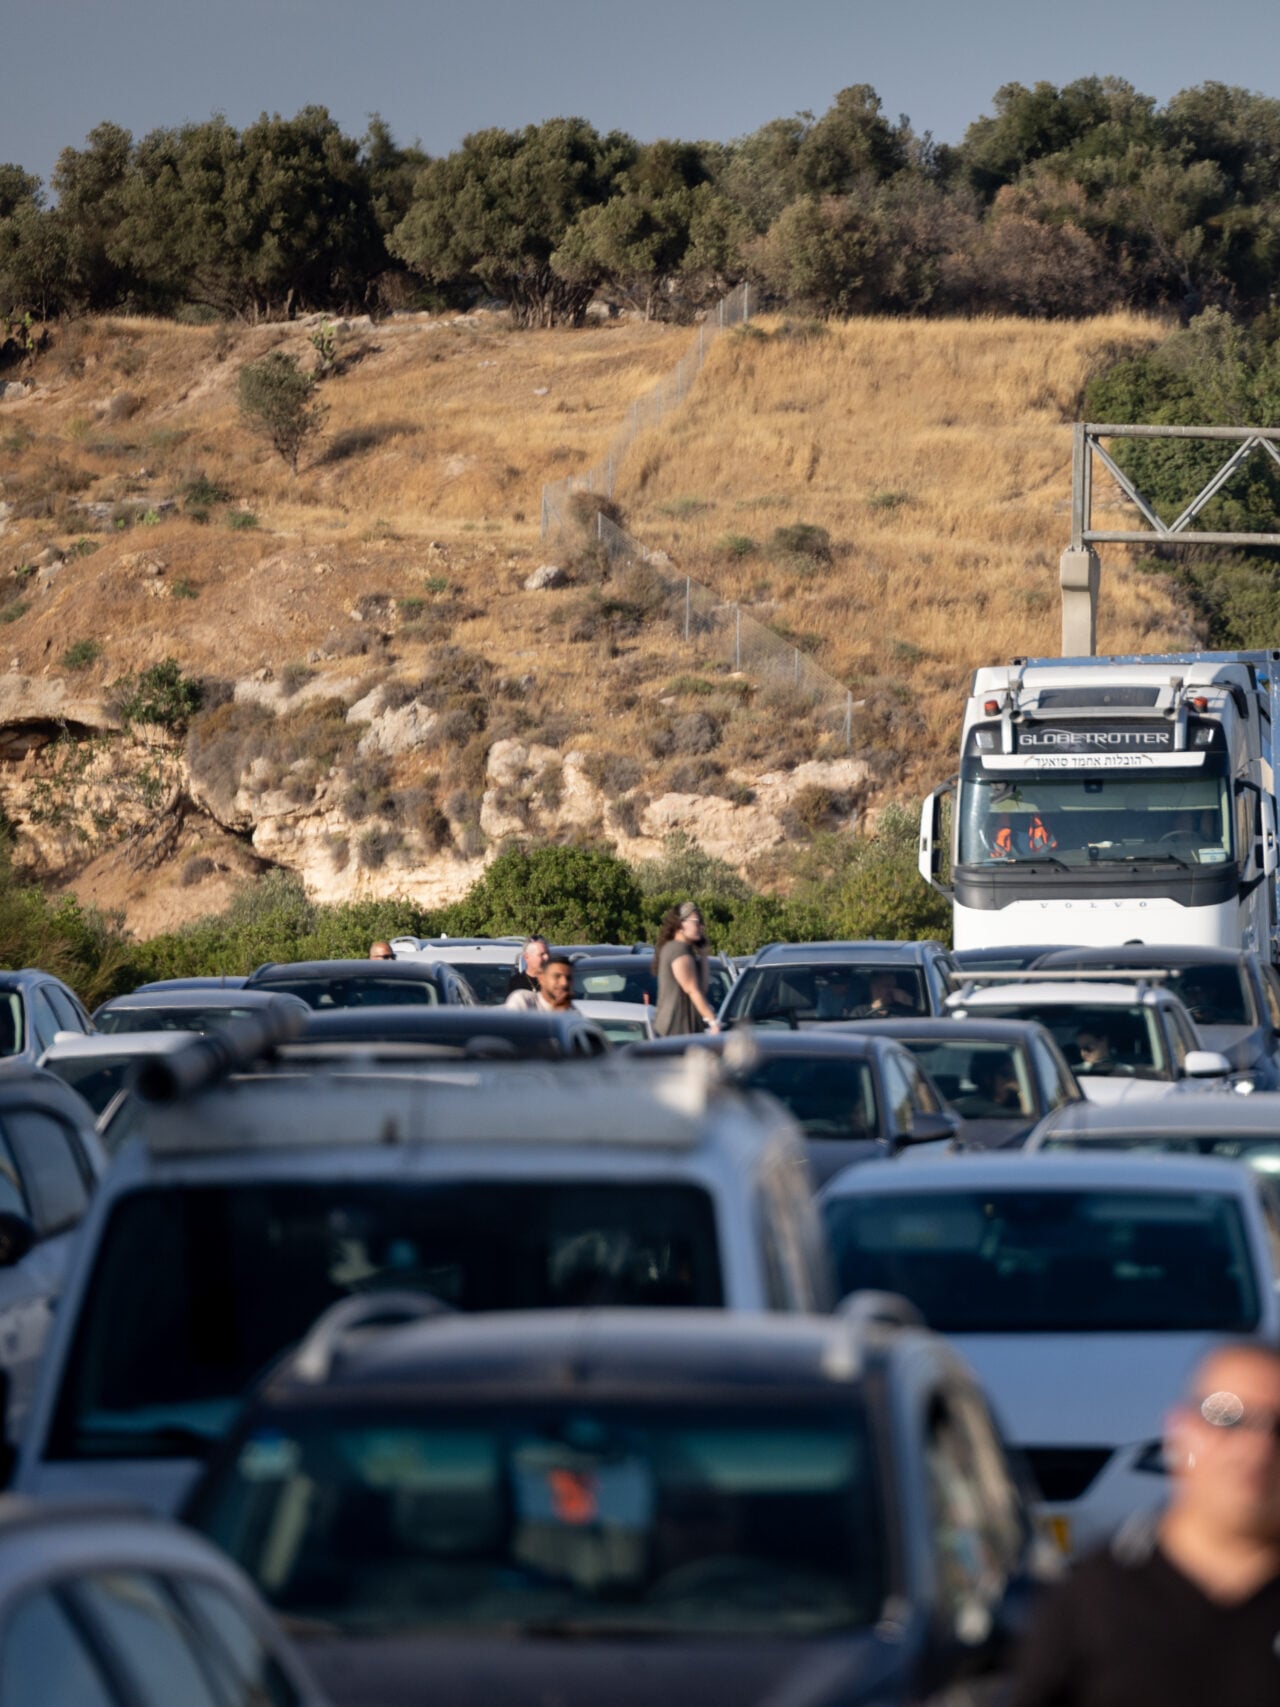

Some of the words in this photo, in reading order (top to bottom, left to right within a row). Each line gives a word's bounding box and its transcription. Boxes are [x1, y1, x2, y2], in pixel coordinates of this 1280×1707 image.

[1019, 732, 1170, 746] GLOBETROTTER
[1104, 754, 1141, 765] הובלות
[1040, 901, 1147, 909] VOLVO
